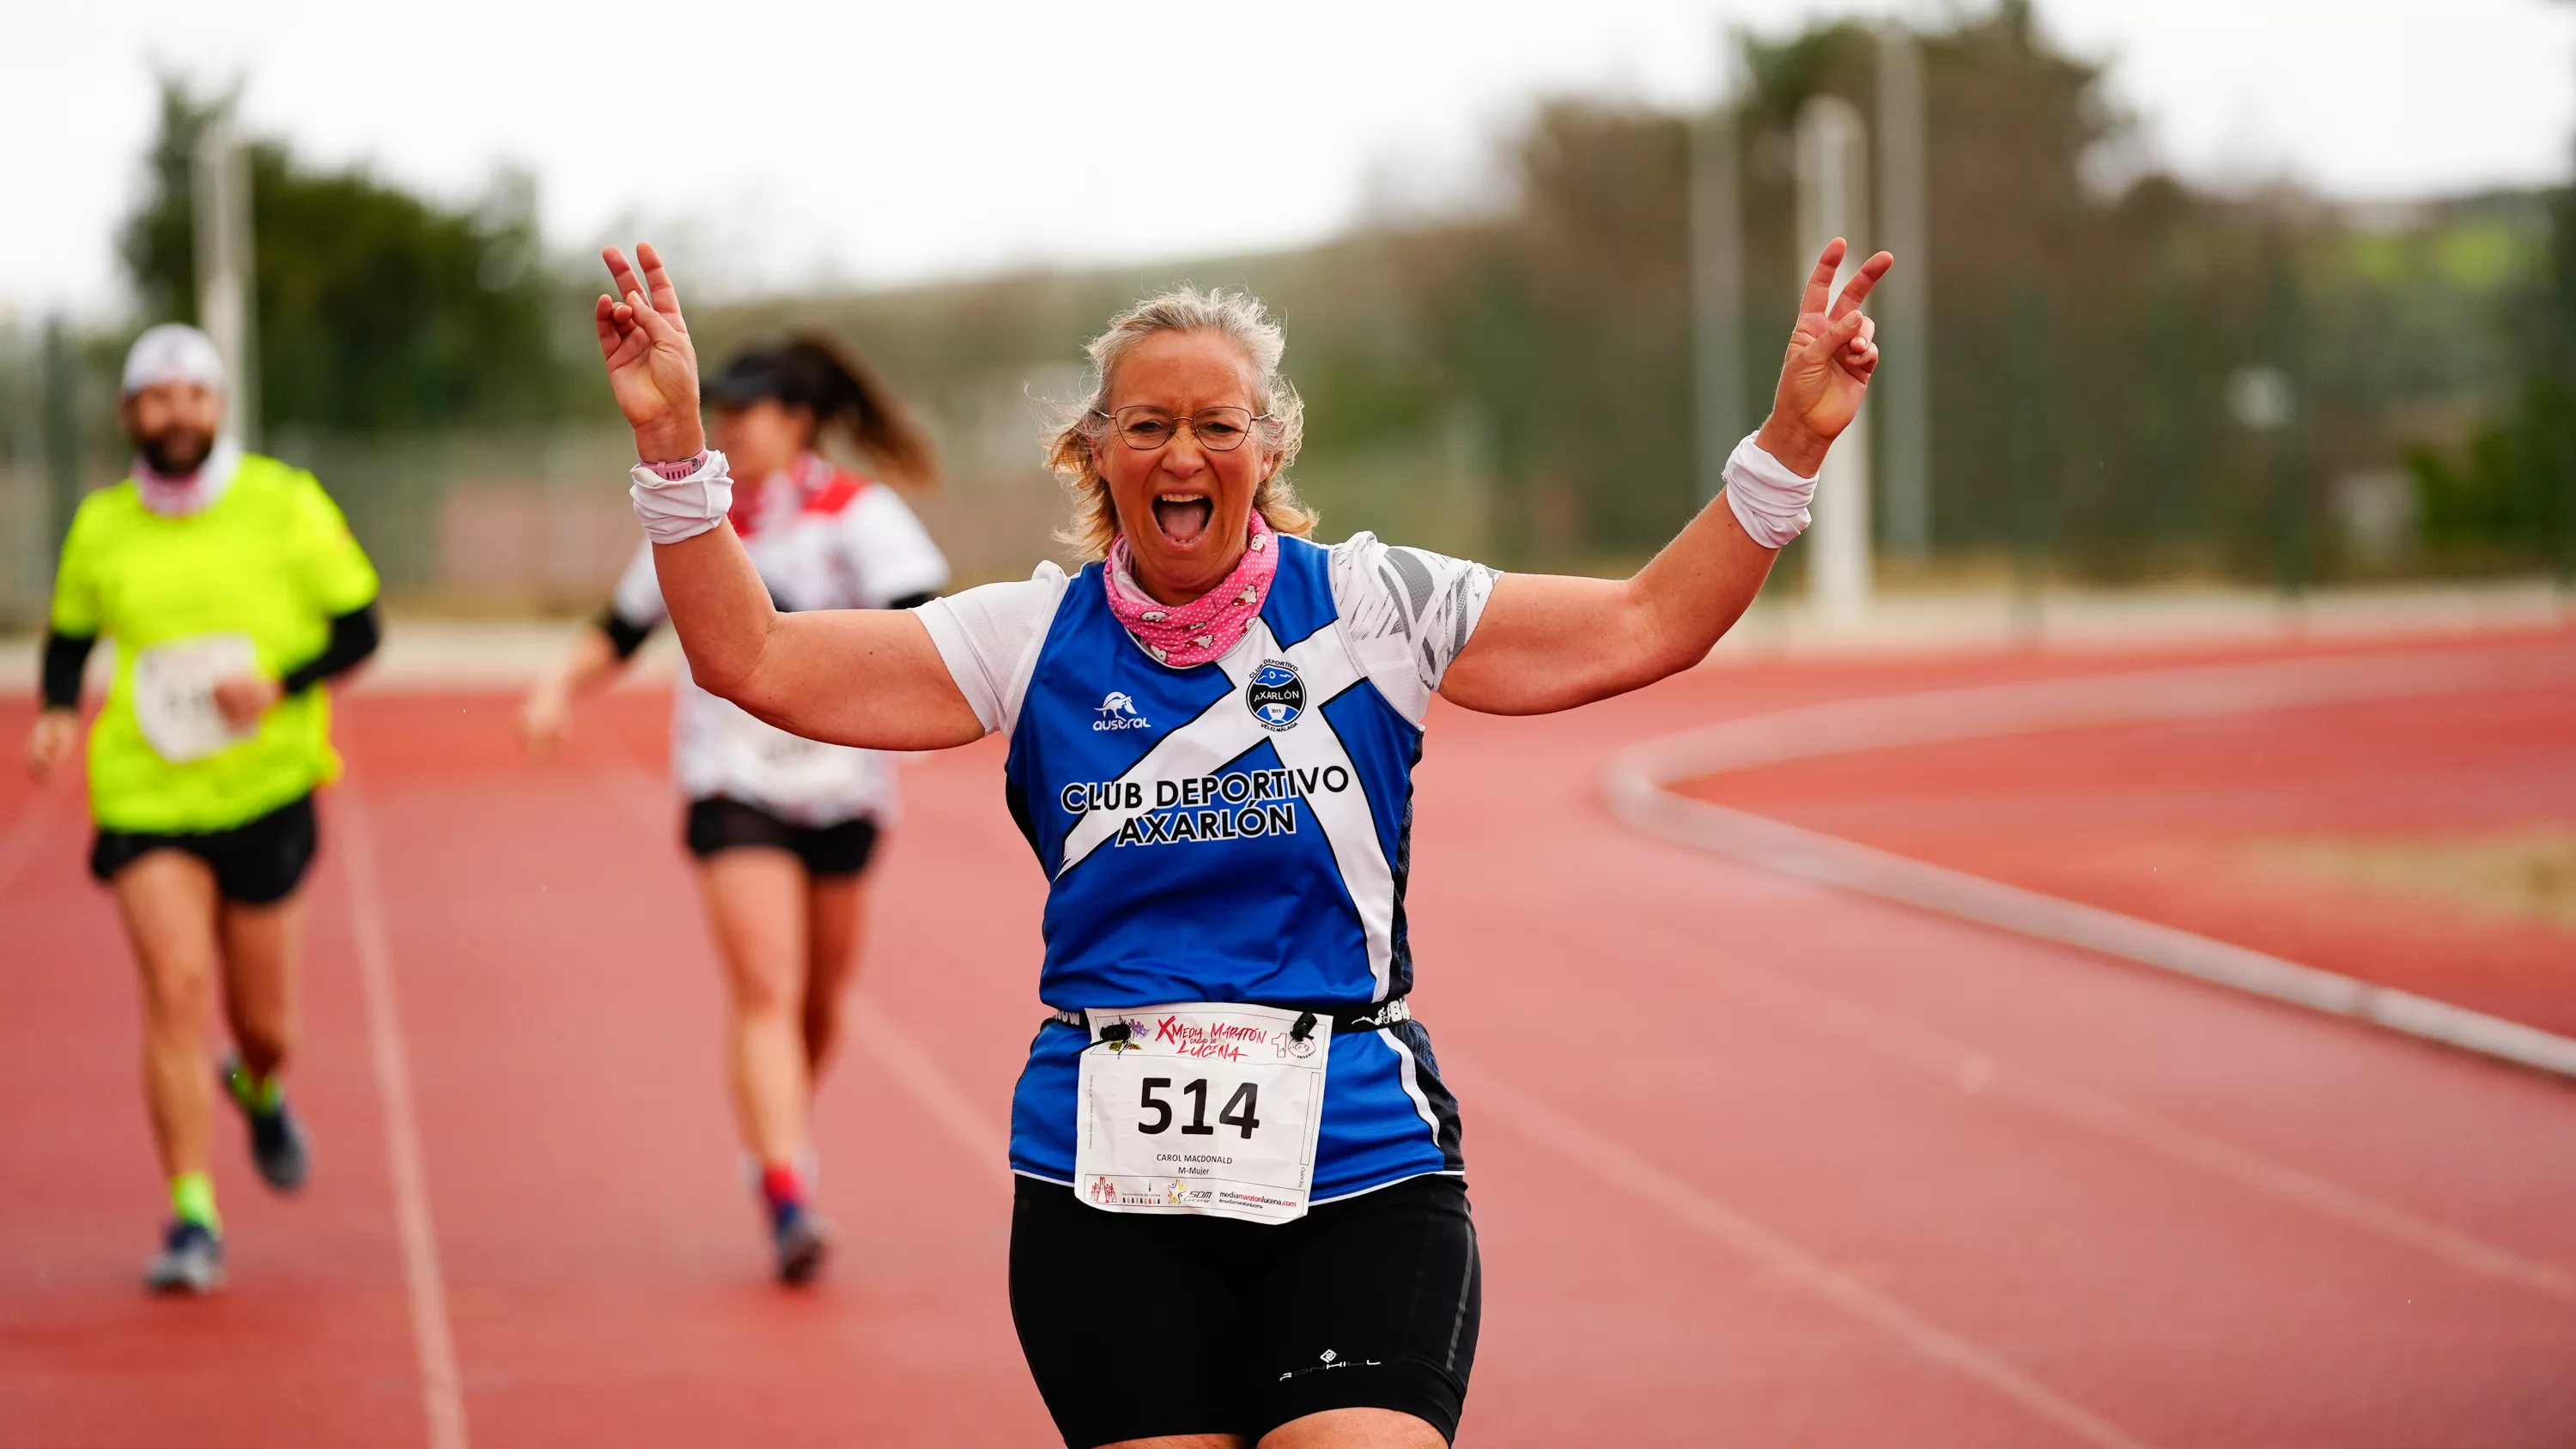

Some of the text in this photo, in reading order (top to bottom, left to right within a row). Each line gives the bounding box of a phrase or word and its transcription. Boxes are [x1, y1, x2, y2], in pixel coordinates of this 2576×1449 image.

[1263, 658, 1298, 671] DEPORTIVO
[1254, 689, 1300, 702] AXARLÓN
[1092, 717, 1151, 731] austral
[1061, 765, 1350, 814] CLUB DEPORTIVO
[1115, 799, 1297, 846] AXARLÓN
[1155, 1016, 1176, 1045] X
[1211, 1022, 1267, 1044] MARATÓN
[1138, 1077, 1261, 1140] 514
[1156, 1154, 1233, 1165] CAROL MACDONALD
[1178, 1167, 1210, 1176] M-Mujer
[1219, 1191, 1297, 1207] mediamaratonlucena.com
